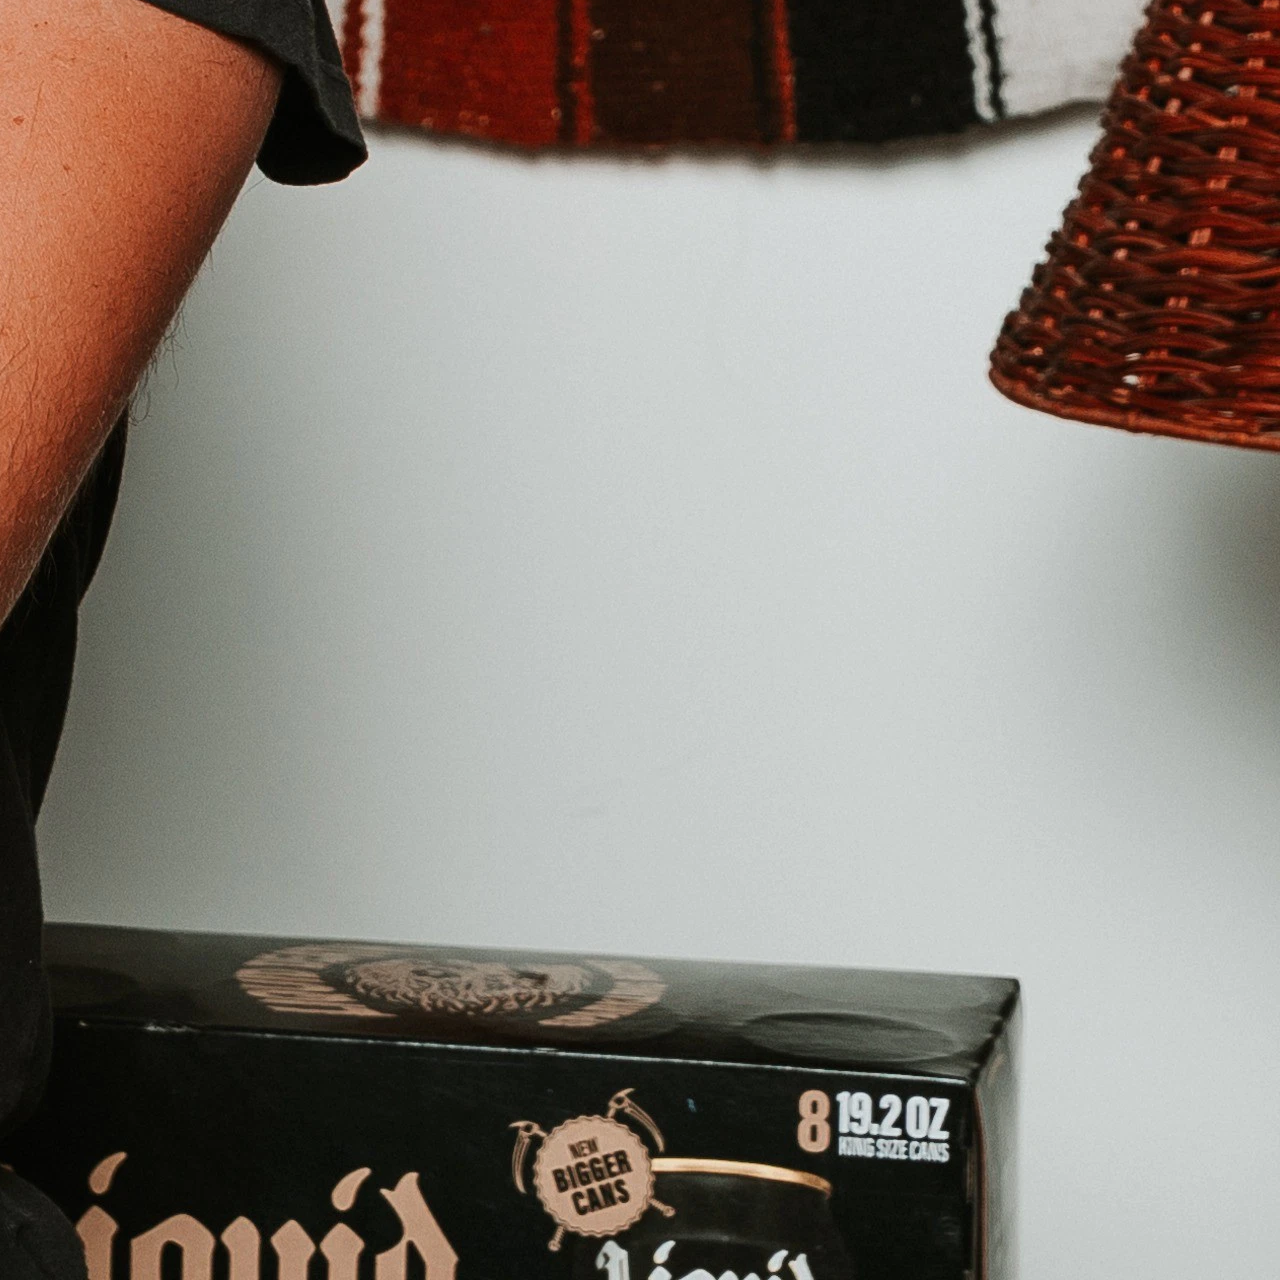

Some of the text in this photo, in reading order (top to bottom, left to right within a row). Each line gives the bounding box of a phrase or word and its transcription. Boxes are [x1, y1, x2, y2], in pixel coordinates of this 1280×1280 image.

[797, 1090, 950, 1153] 8 19.2 OZ
[568, 1137, 599, 1159] NEW
[838, 1136, 950, 1163] KING SIZE CANS
[552, 1149, 633, 1194] BIGGER
[572, 1179, 631, 1216] CANS
